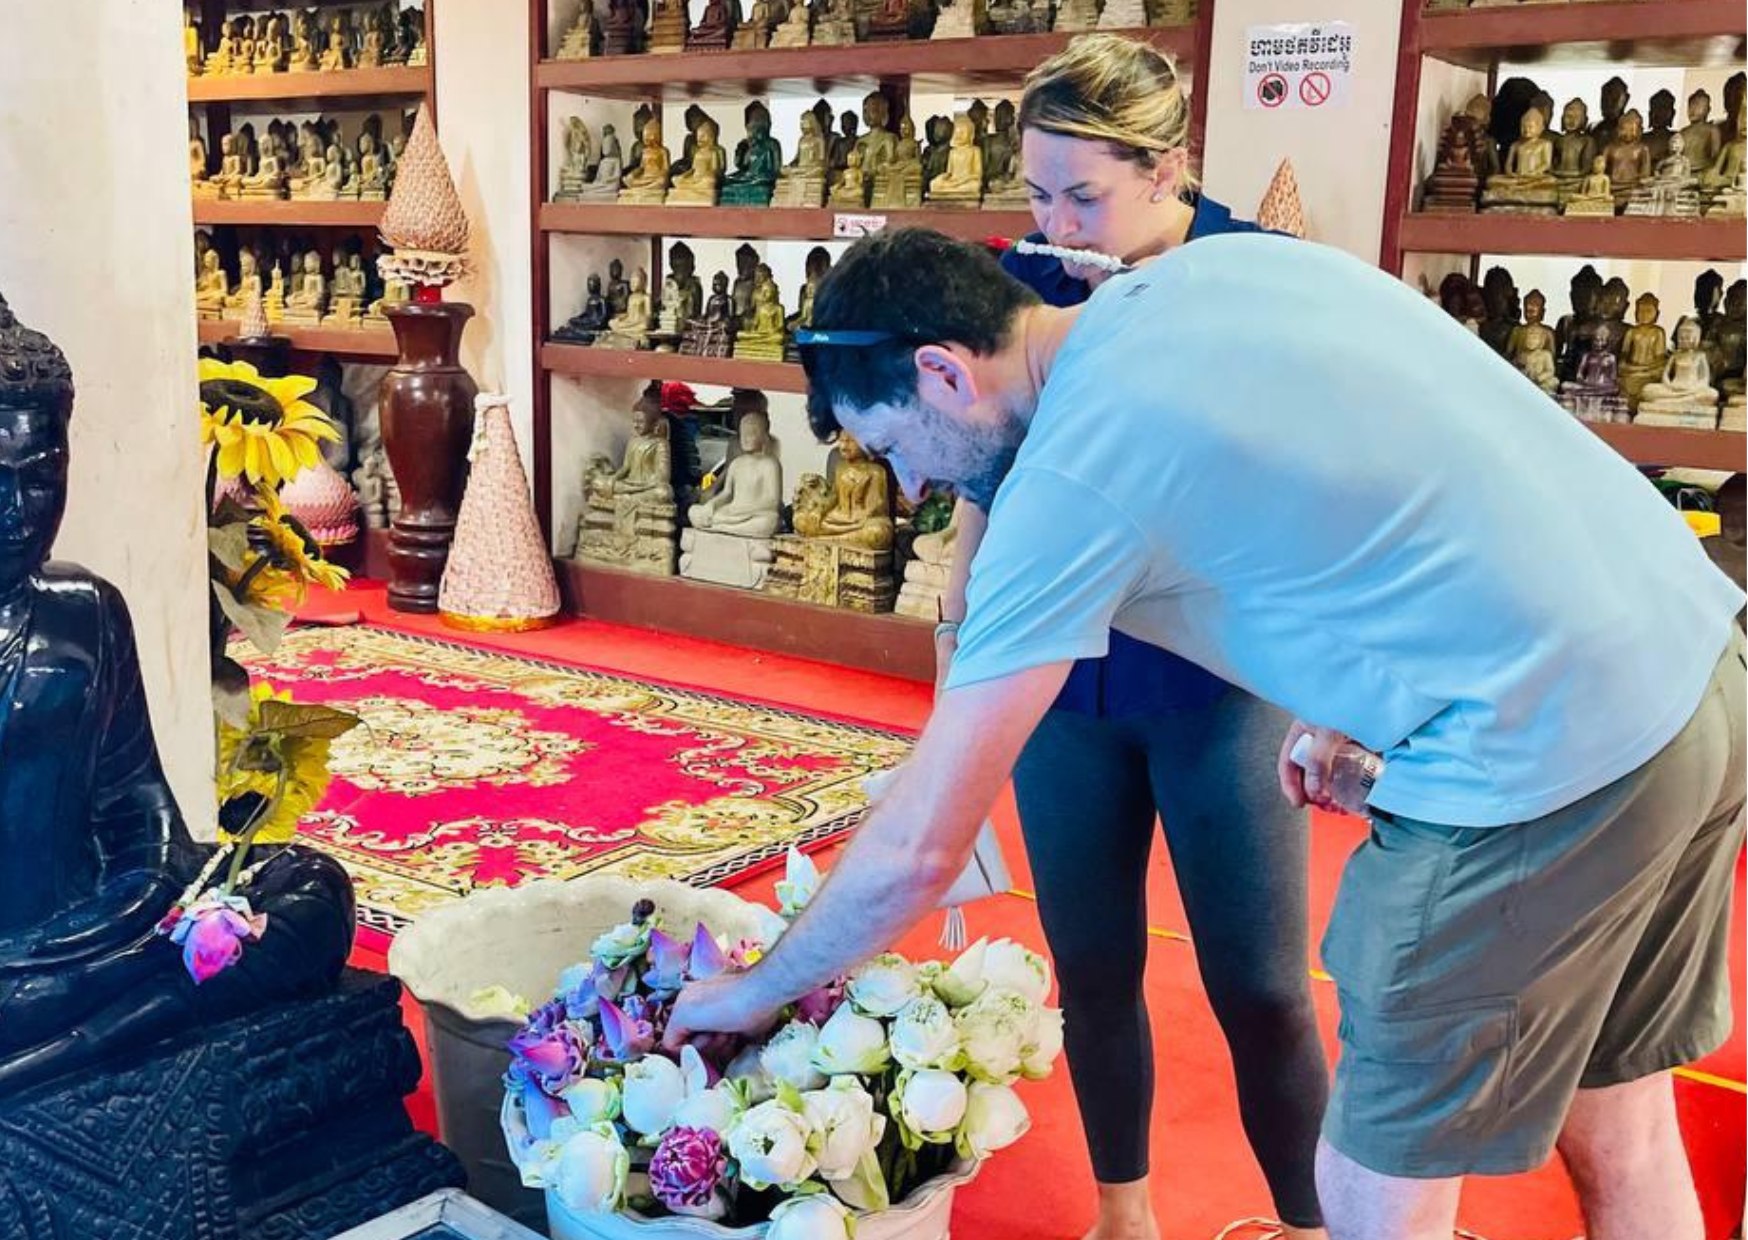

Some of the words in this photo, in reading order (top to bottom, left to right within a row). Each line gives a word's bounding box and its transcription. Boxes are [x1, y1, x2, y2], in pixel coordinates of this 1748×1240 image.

[1248, 61, 1273, 73] Don't
[1274, 60, 1300, 72] Video
[1301, 59, 1350, 72] Recording
